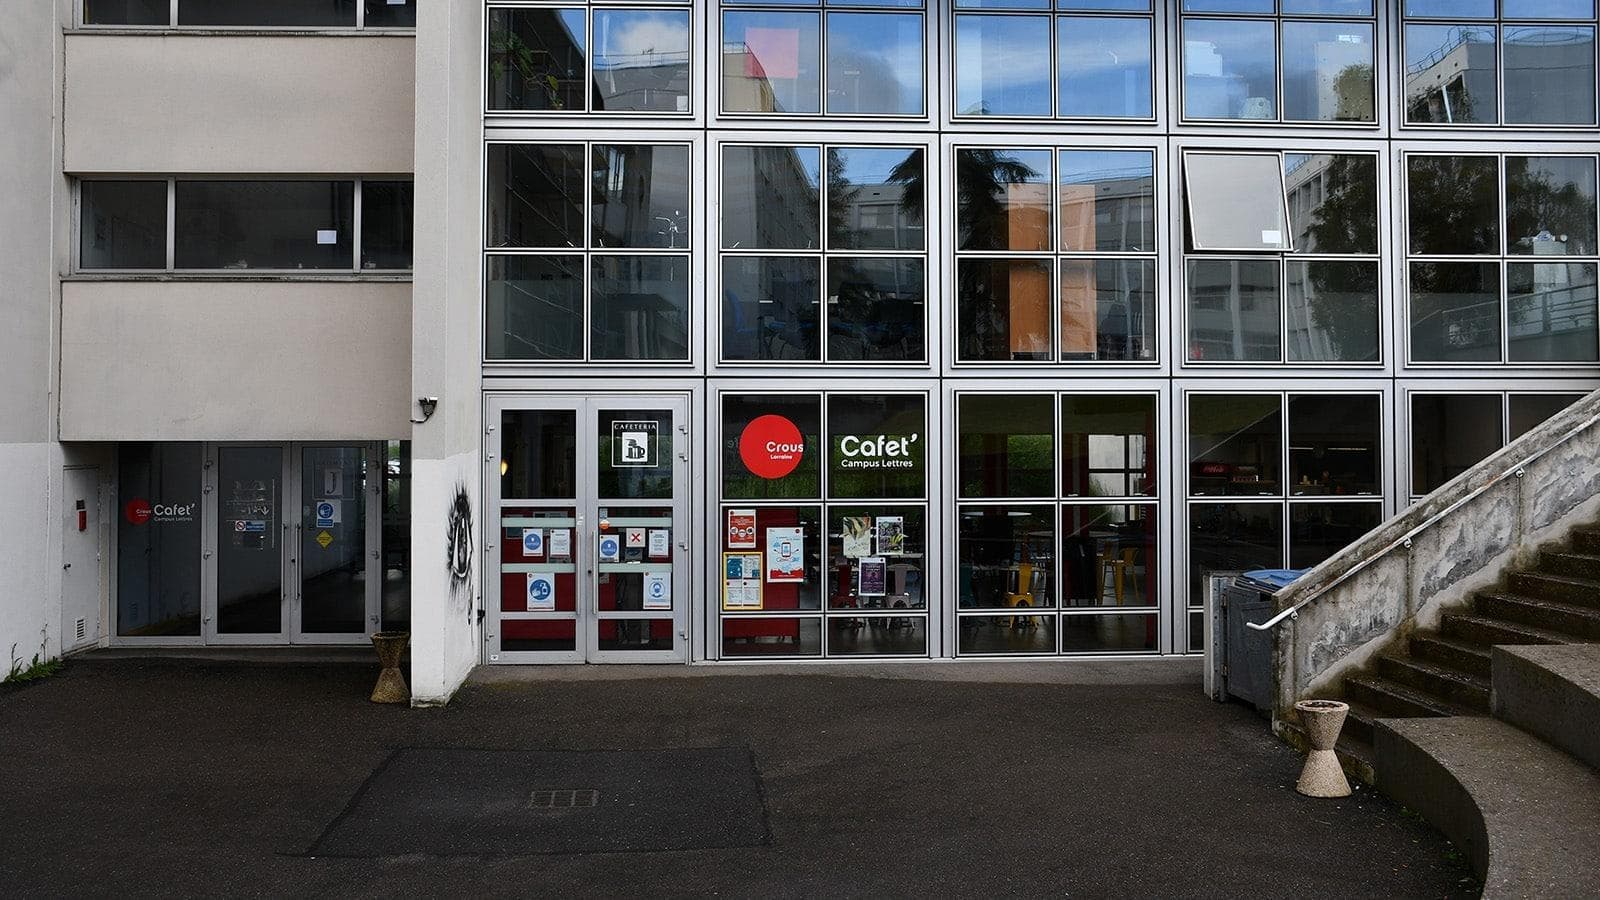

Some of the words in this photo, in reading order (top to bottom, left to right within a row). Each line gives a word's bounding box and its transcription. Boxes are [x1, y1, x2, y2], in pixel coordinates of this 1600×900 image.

[766, 441, 804, 453] Crous
[841, 459, 880, 469] Campus
[882, 459, 913, 468] Lettres
